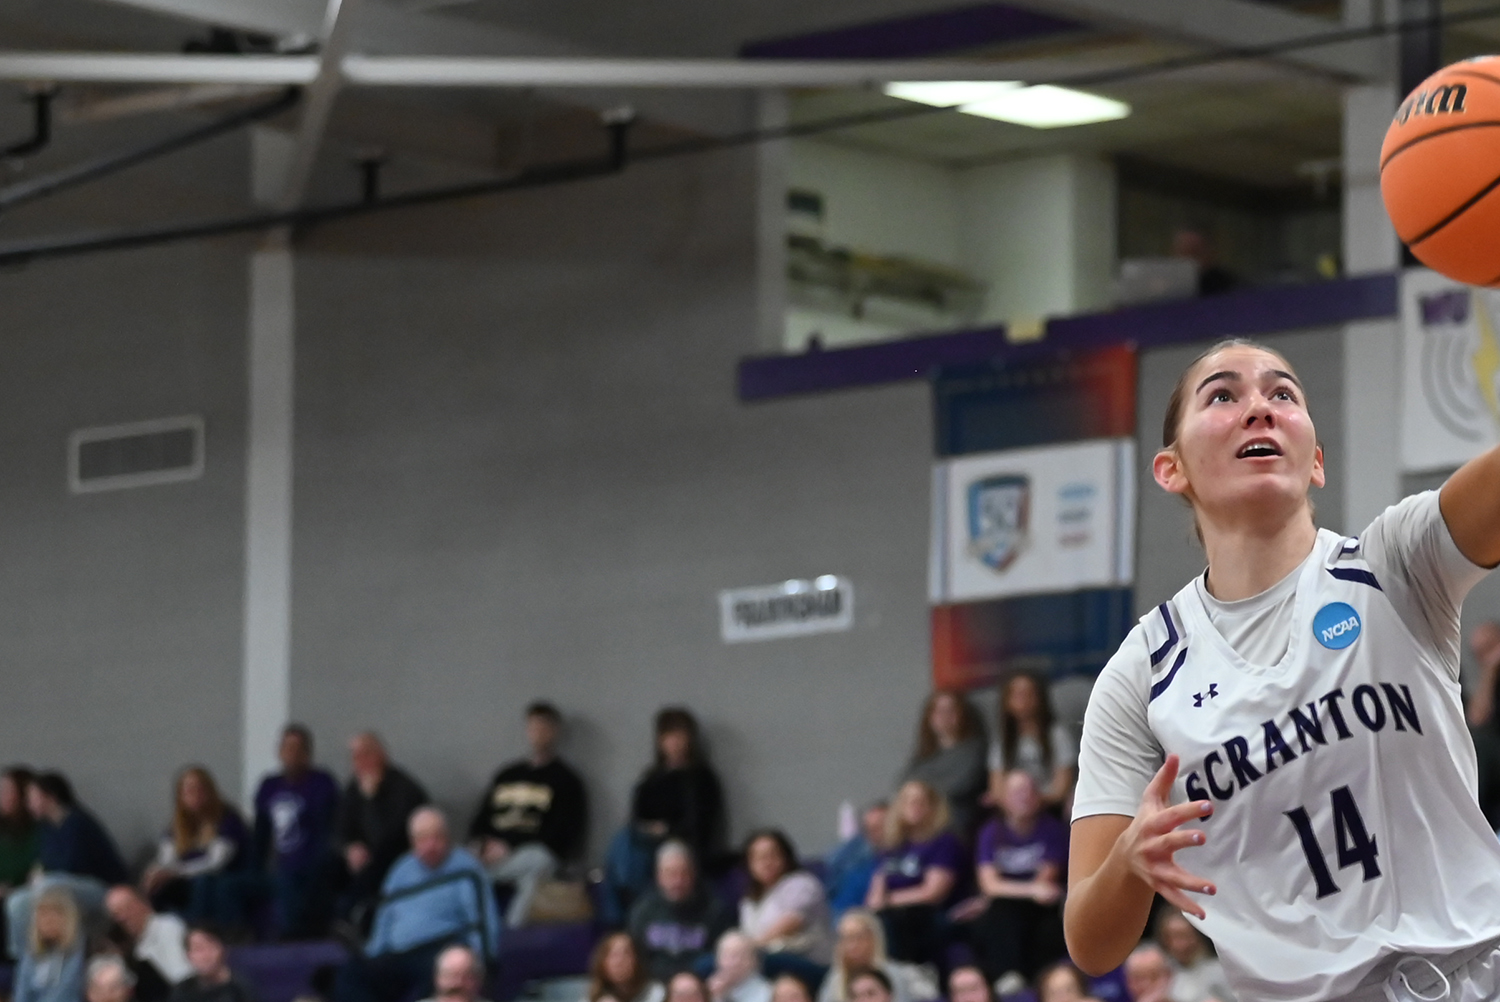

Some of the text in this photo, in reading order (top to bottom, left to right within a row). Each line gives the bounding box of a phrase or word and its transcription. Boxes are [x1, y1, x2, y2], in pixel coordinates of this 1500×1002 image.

[1321, 616, 1359, 642] NCAA
[1185, 682, 1424, 822] SCRANTON
[1282, 784, 1383, 900] 14
